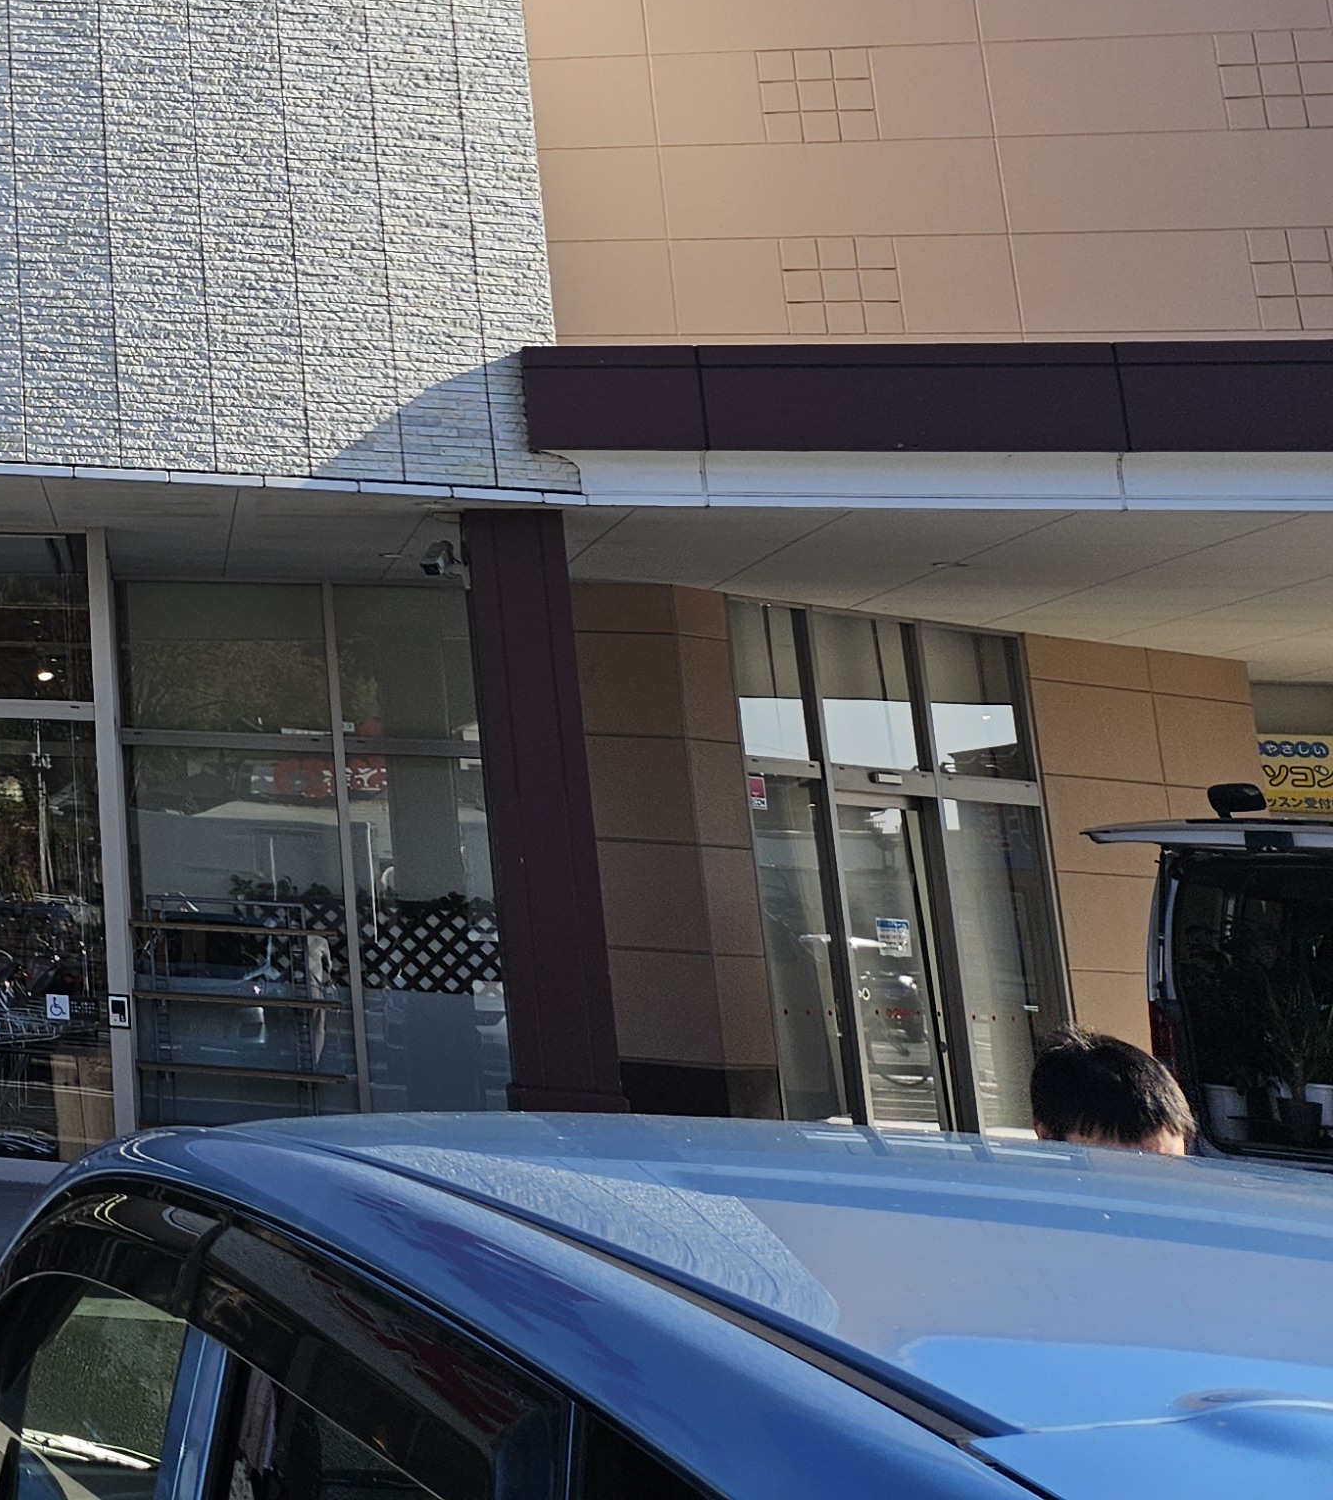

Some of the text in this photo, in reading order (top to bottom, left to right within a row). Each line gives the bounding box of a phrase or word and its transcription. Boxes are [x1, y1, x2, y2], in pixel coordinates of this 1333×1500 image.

[1265, 743, 1327, 755] やさしい
[1267, 796, 1333, 809] ッスン受付
